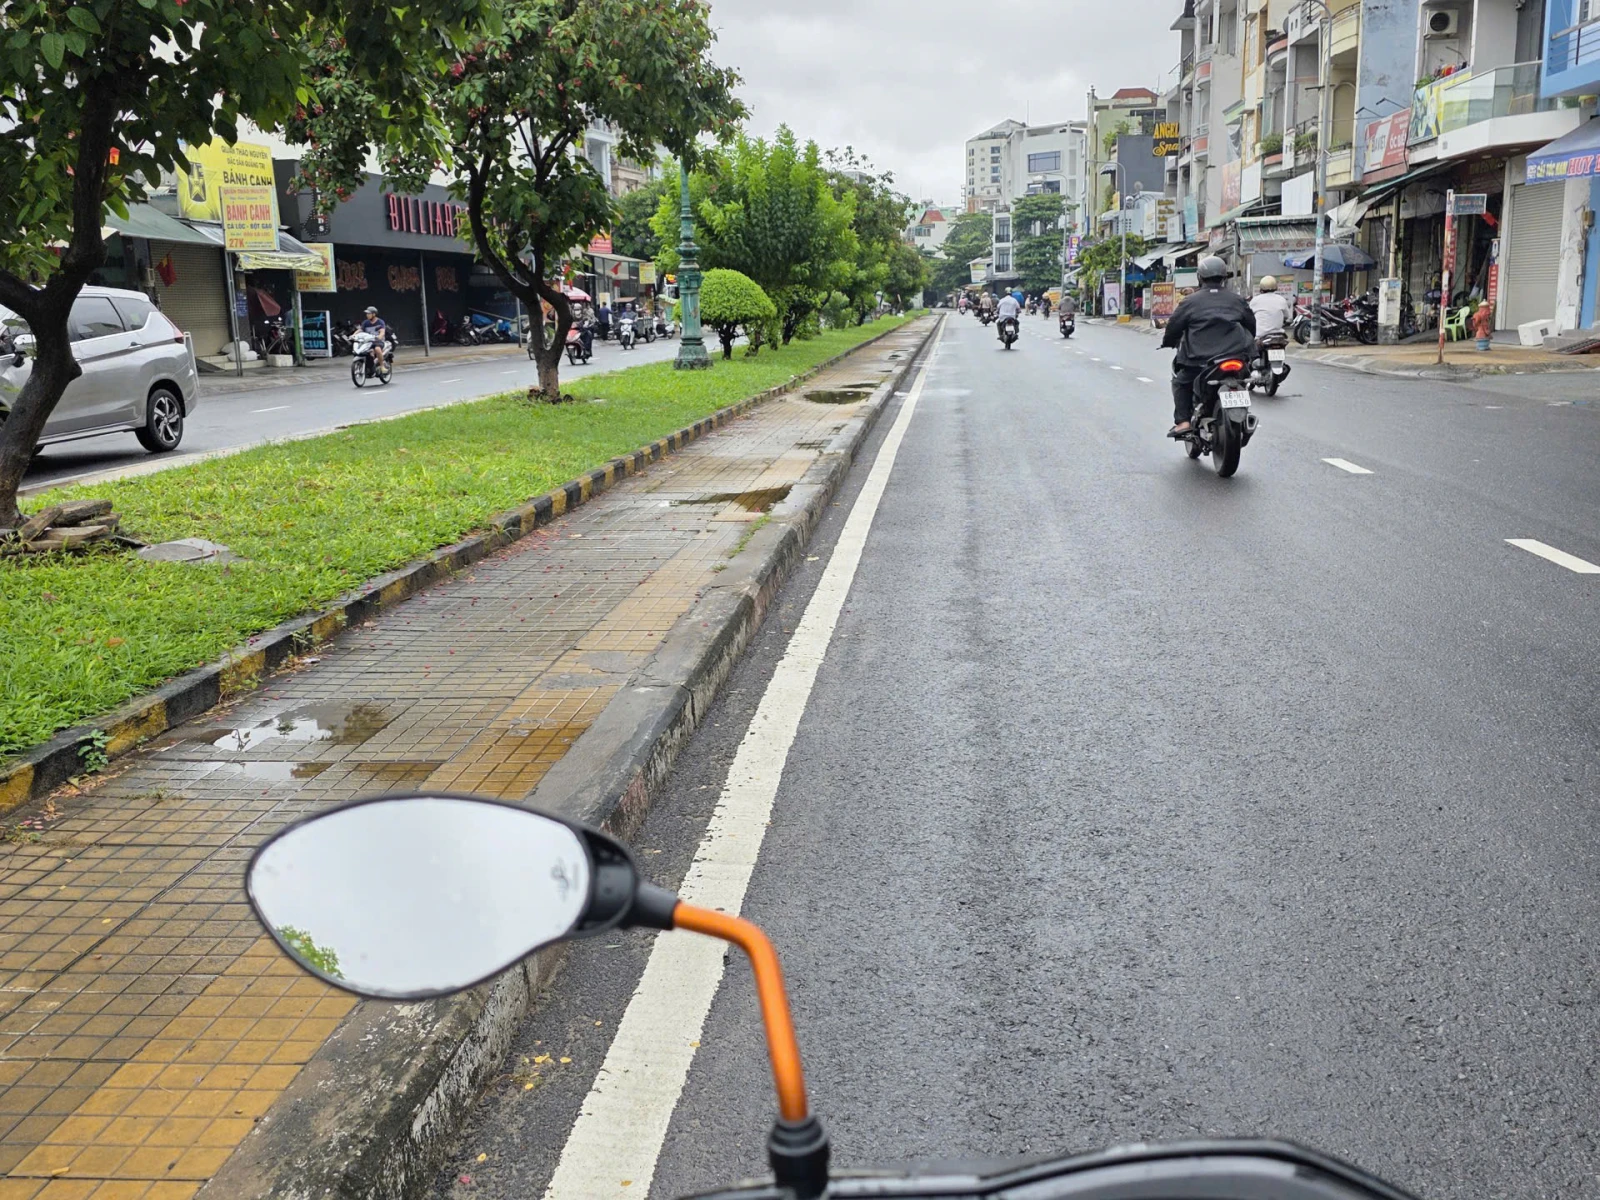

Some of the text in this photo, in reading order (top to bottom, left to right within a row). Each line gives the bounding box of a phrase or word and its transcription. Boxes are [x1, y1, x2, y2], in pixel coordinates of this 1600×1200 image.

[1153, 121, 1180, 139] ANGEL
[1152, 141, 1179, 156] Spa
[1567, 155, 1595, 177] HUY
[249, 174, 273, 187] CANH
[226, 201, 271, 221] BÁNH CANH
[229, 238, 245, 248] 27K
[304, 340, 326, 348] CLUB
